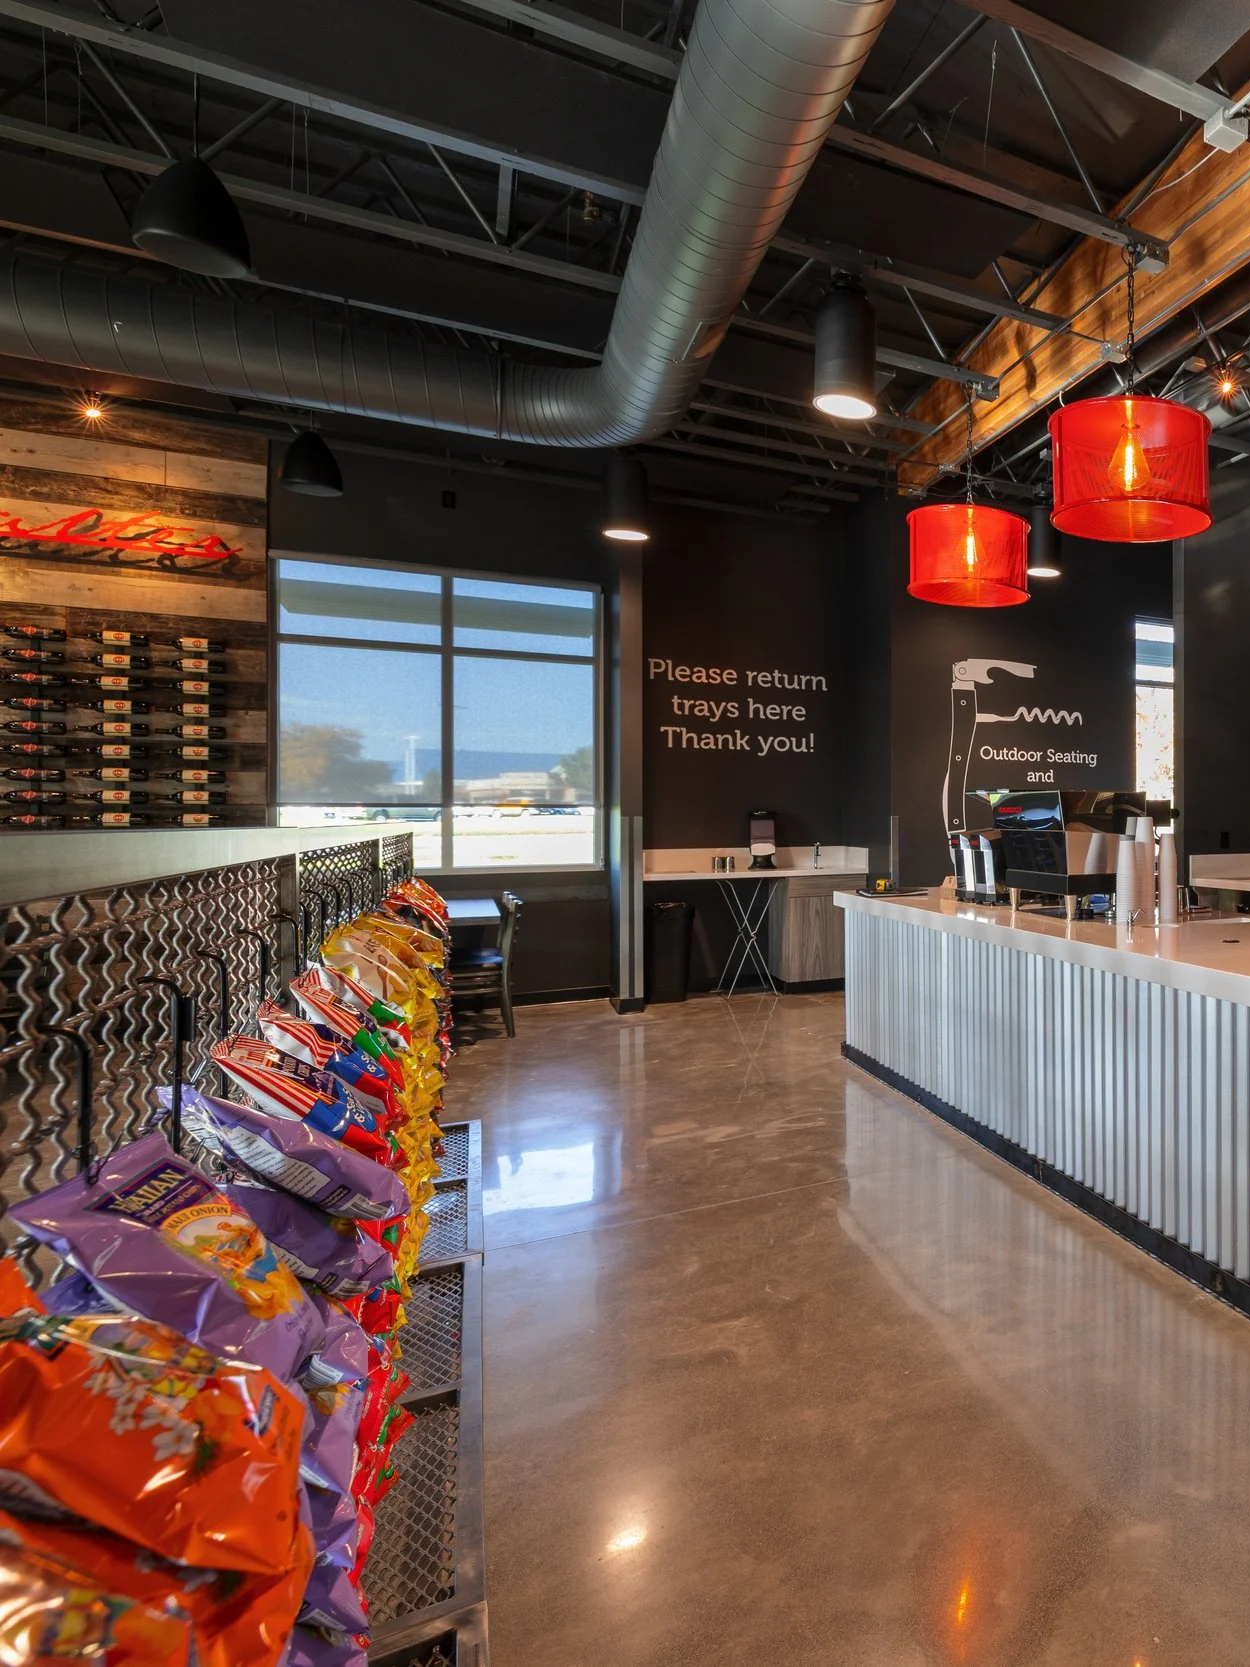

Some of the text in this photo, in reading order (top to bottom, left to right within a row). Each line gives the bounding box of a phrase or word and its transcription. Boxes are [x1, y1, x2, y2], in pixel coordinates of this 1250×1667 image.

[648, 658, 827, 691] Please return
[672, 695, 806, 722] trays here
[660, 726, 814, 756] Thank you!
[980, 745, 1098, 767] Outdoor Seating
[1027, 769, 1054, 783] and
[167, 1206, 228, 1230] MAUI ONION
